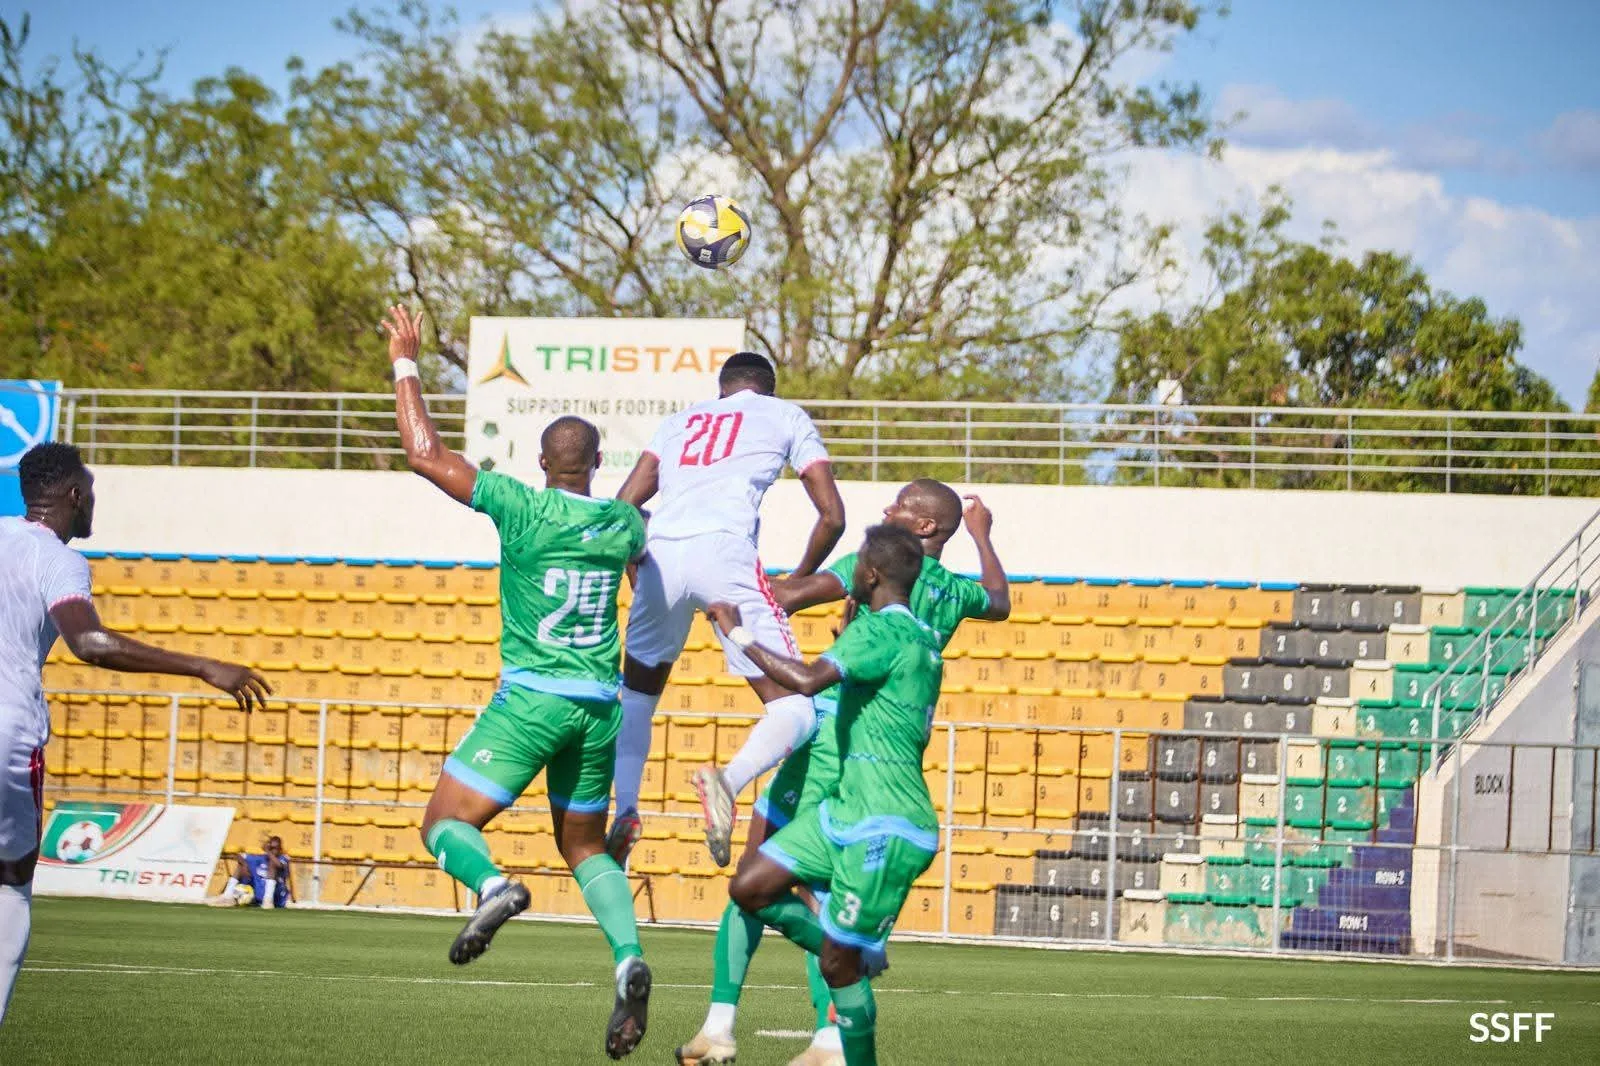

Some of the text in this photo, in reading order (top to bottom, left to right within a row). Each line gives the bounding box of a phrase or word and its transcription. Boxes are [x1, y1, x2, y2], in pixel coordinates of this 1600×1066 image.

[507, 399, 609, 415] SUPPORTING
[679, 412, 742, 467] 20
[537, 567, 611, 648] 29
[1311, 598, 1320, 615] 7
[1320, 640, 1328, 656] 6
[1284, 673, 1293, 690] 6
[1204, 711, 1213, 728] 7
[1244, 711, 1253, 729] 6
[1286, 712, 1295, 729] 5
[1409, 718, 1419, 735] 2
[1165, 749, 1174, 766] 7
[1207, 750, 1216, 767] 6
[1247, 751, 1256, 768] 5
[1126, 788, 1135, 805] 7
[1170, 791, 1179, 807] 6
[1211, 793, 1220, 809] 5
[1294, 794, 1304, 811] 3
[1337, 796, 1347, 813] 2
[98, 869, 207, 887] TRISTAR
[1048, 869, 1057, 885] 7
[1091, 869, 1100, 885] 6
[1135, 872, 1144, 887] 5
[1261, 875, 1271, 891] 2
[1307, 877, 1314, 893] 1
[837, 892, 861, 927] 3
[1010, 905, 1019, 922] 7
[1050, 905, 1060, 921] 6
[1090, 911, 1099, 927] 5
